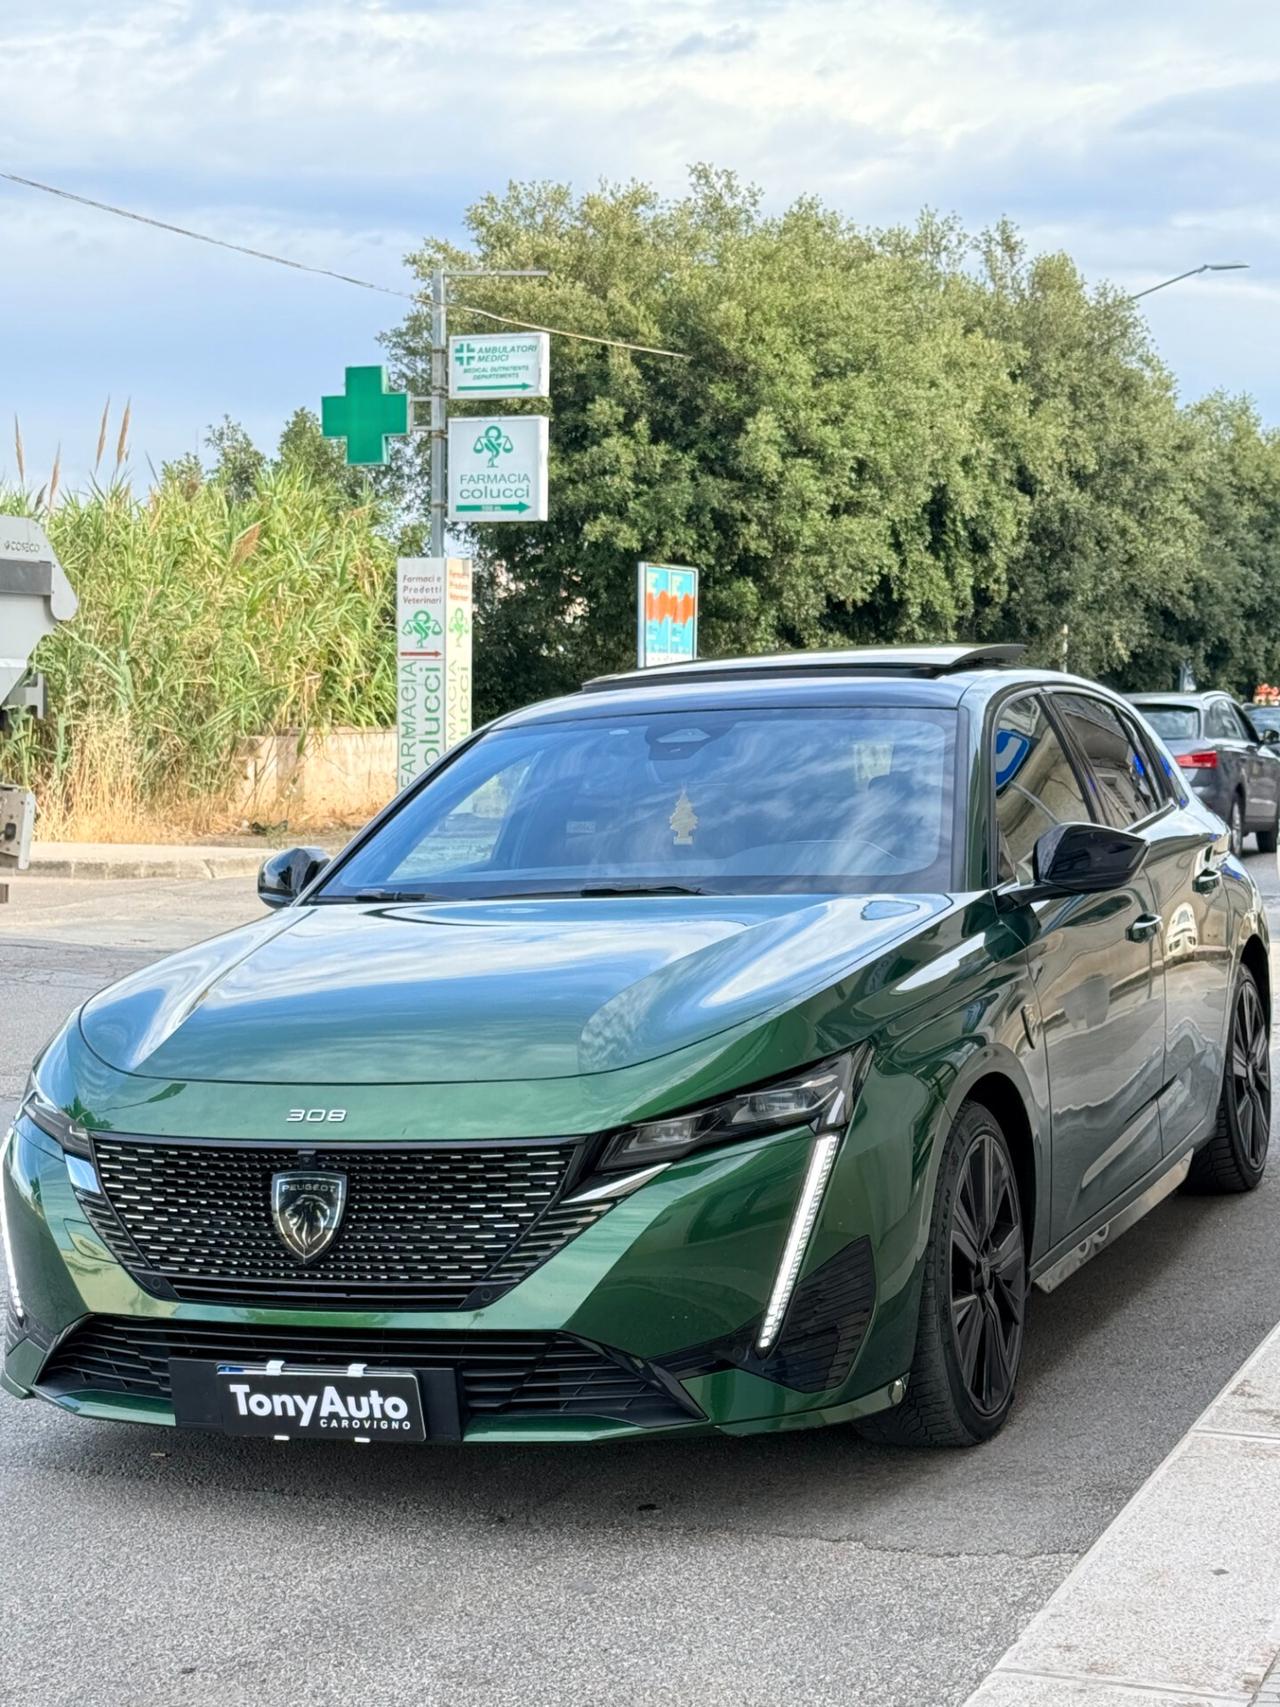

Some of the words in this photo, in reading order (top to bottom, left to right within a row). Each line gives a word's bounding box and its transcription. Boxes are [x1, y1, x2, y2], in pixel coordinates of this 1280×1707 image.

[477, 344, 537, 354] AMBULATORI
[460, 473, 531, 484] FARMACIA
[460, 485, 530, 499] colucci
[403, 574, 435, 583] Farmaci
[403, 585, 442, 594] Prodotti
[403, 596, 442, 605] Veterinari
[419, 667, 440, 766] olucci
[286, 1109, 347, 1122] 308
[281, 1184, 336, 1193] PEUGEOT
[319, 1419, 411, 1430] CAROVIGNO
